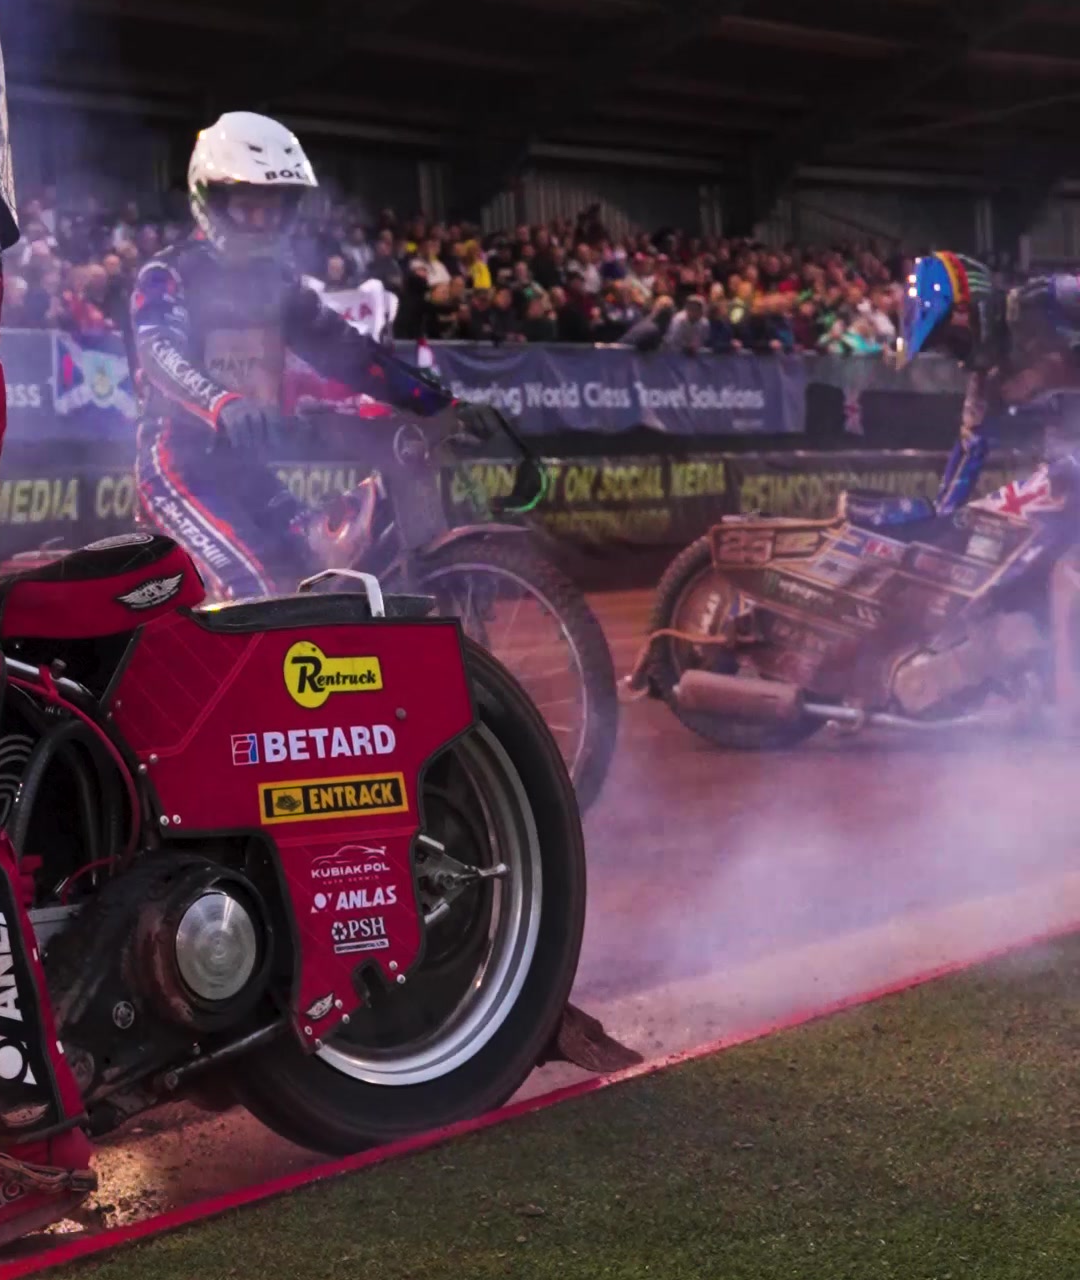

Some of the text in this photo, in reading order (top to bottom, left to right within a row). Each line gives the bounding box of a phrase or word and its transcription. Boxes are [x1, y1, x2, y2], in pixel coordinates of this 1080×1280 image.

[687, 384, 765, 410] Solutions
[290, 655, 377, 693] Rentruck
[263, 724, 396, 763] BETARD
[309, 781, 395, 810] ENTRACK
[335, 885, 397, 911] ANLAS
[347, 916, 386, 939] PSH
